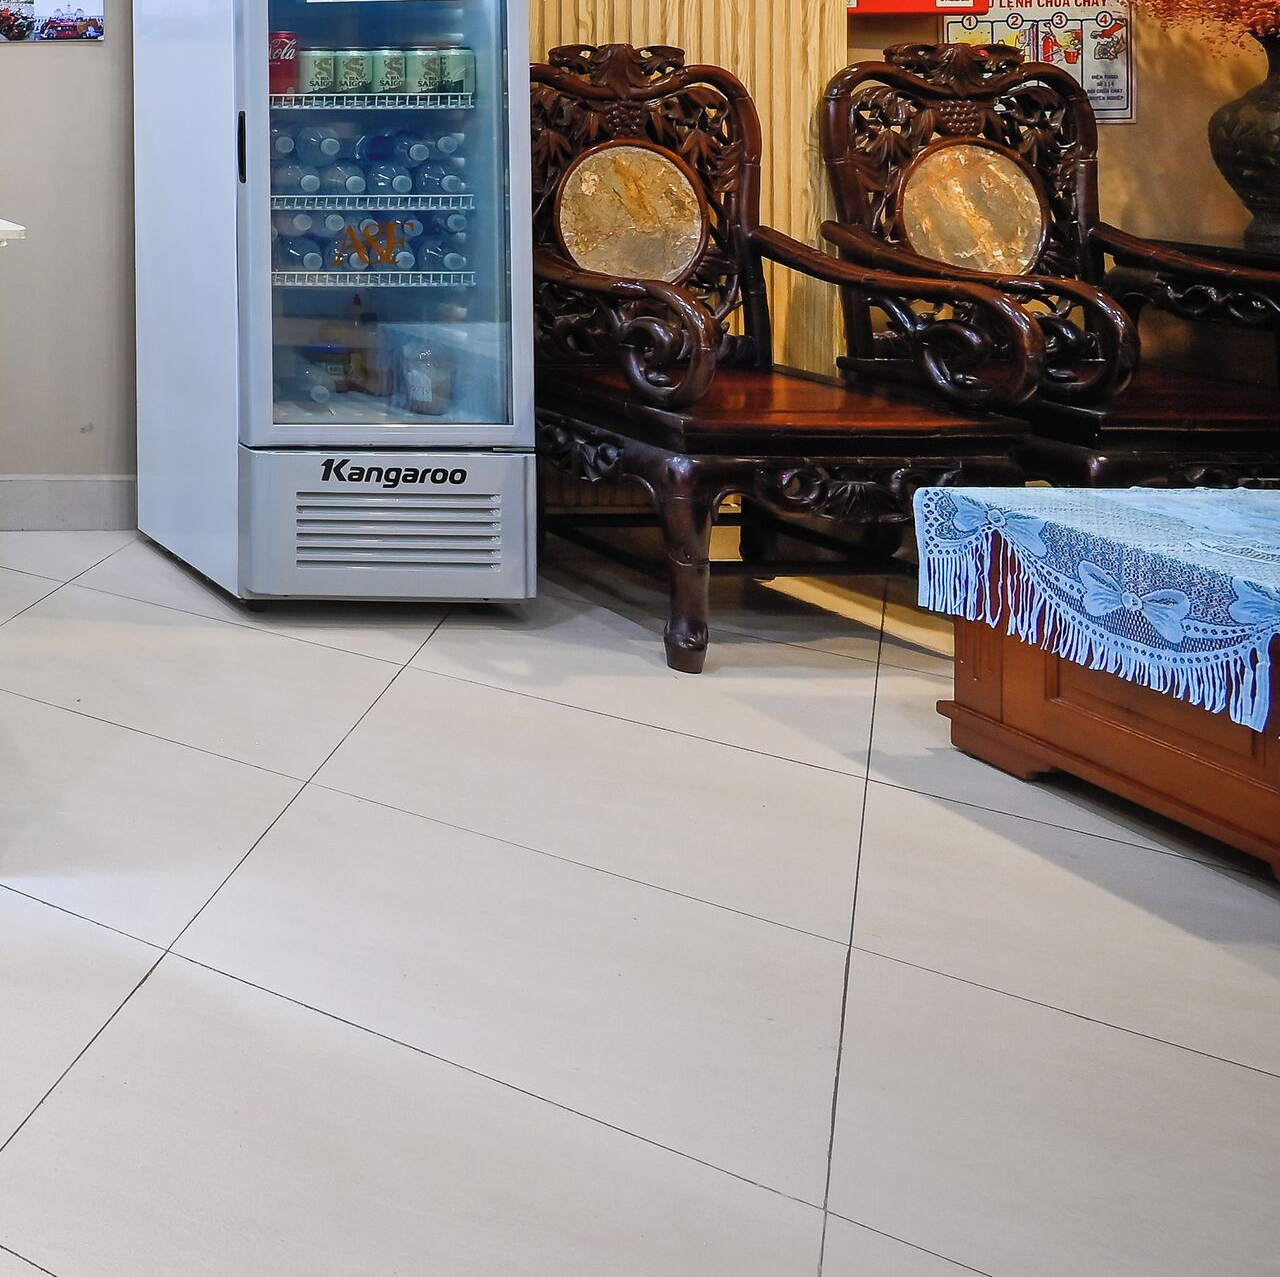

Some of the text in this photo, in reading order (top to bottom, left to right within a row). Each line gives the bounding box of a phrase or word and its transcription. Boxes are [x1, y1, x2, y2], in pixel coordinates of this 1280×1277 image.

[966, 17, 972, 26] 1
[1010, 15, 1019, 26] 2
[1055, 15, 1063, 25] 3
[1100, 14, 1108, 24] 4
